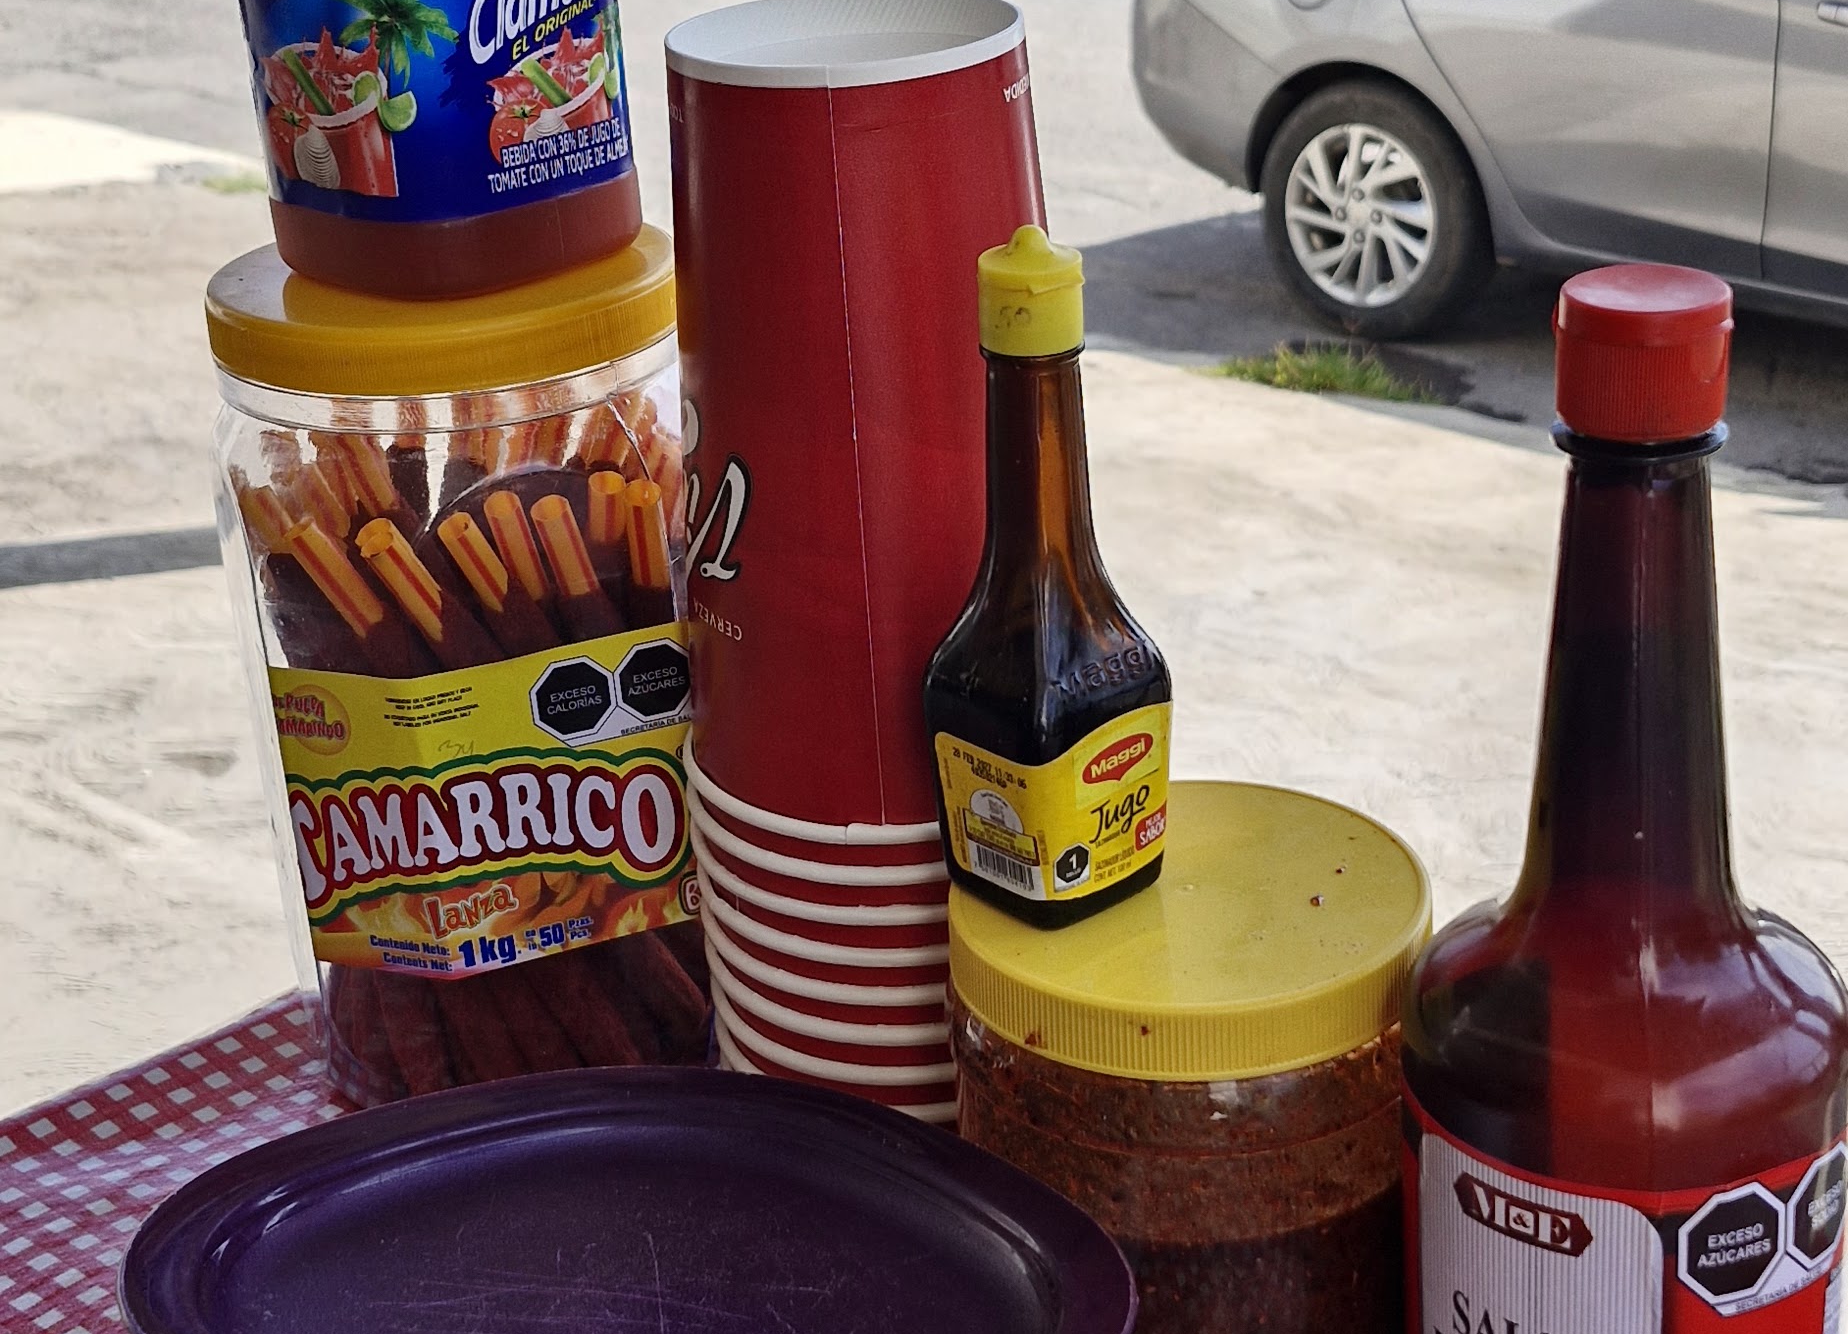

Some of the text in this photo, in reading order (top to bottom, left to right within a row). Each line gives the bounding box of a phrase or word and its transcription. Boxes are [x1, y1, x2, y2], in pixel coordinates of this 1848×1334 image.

[512, 35, 530, 60] EL
[502, 118, 620, 168] BEBIDA CON 36% DE JUGO DE
[488, 168, 528, 193] TOMATE
[529, 161, 549, 184] CON
[550, 158, 565, 179] UN
[565, 152, 594, 176] TOQUE
[595, 147, 605, 166] DE
[692, 598, 743, 641] CERVEZA
[628, 676, 686, 696] AZÚCARES
[633, 667, 678, 684] EXCESO
[547, 695, 602, 715] CALORÍAS
[550, 685, 596, 703] EXCESO
[667, 717, 677, 726] DE
[1090, 737, 1146, 778] Maggi
[1089, 785, 1149, 844] Jugo
[1069, 853, 1077, 870] 1
[370, 935, 420, 952] Contenido
[422, 943, 451, 955] Neto:
[458, 940, 476, 967] 1
[539, 923, 564, 947] 50
[383, 952, 428, 969] Contents
[431, 959, 453, 972] Net:
[1707, 1223, 1764, 1250] EXCESO
[1697, 1238, 1771, 1268] AZÚCARES
